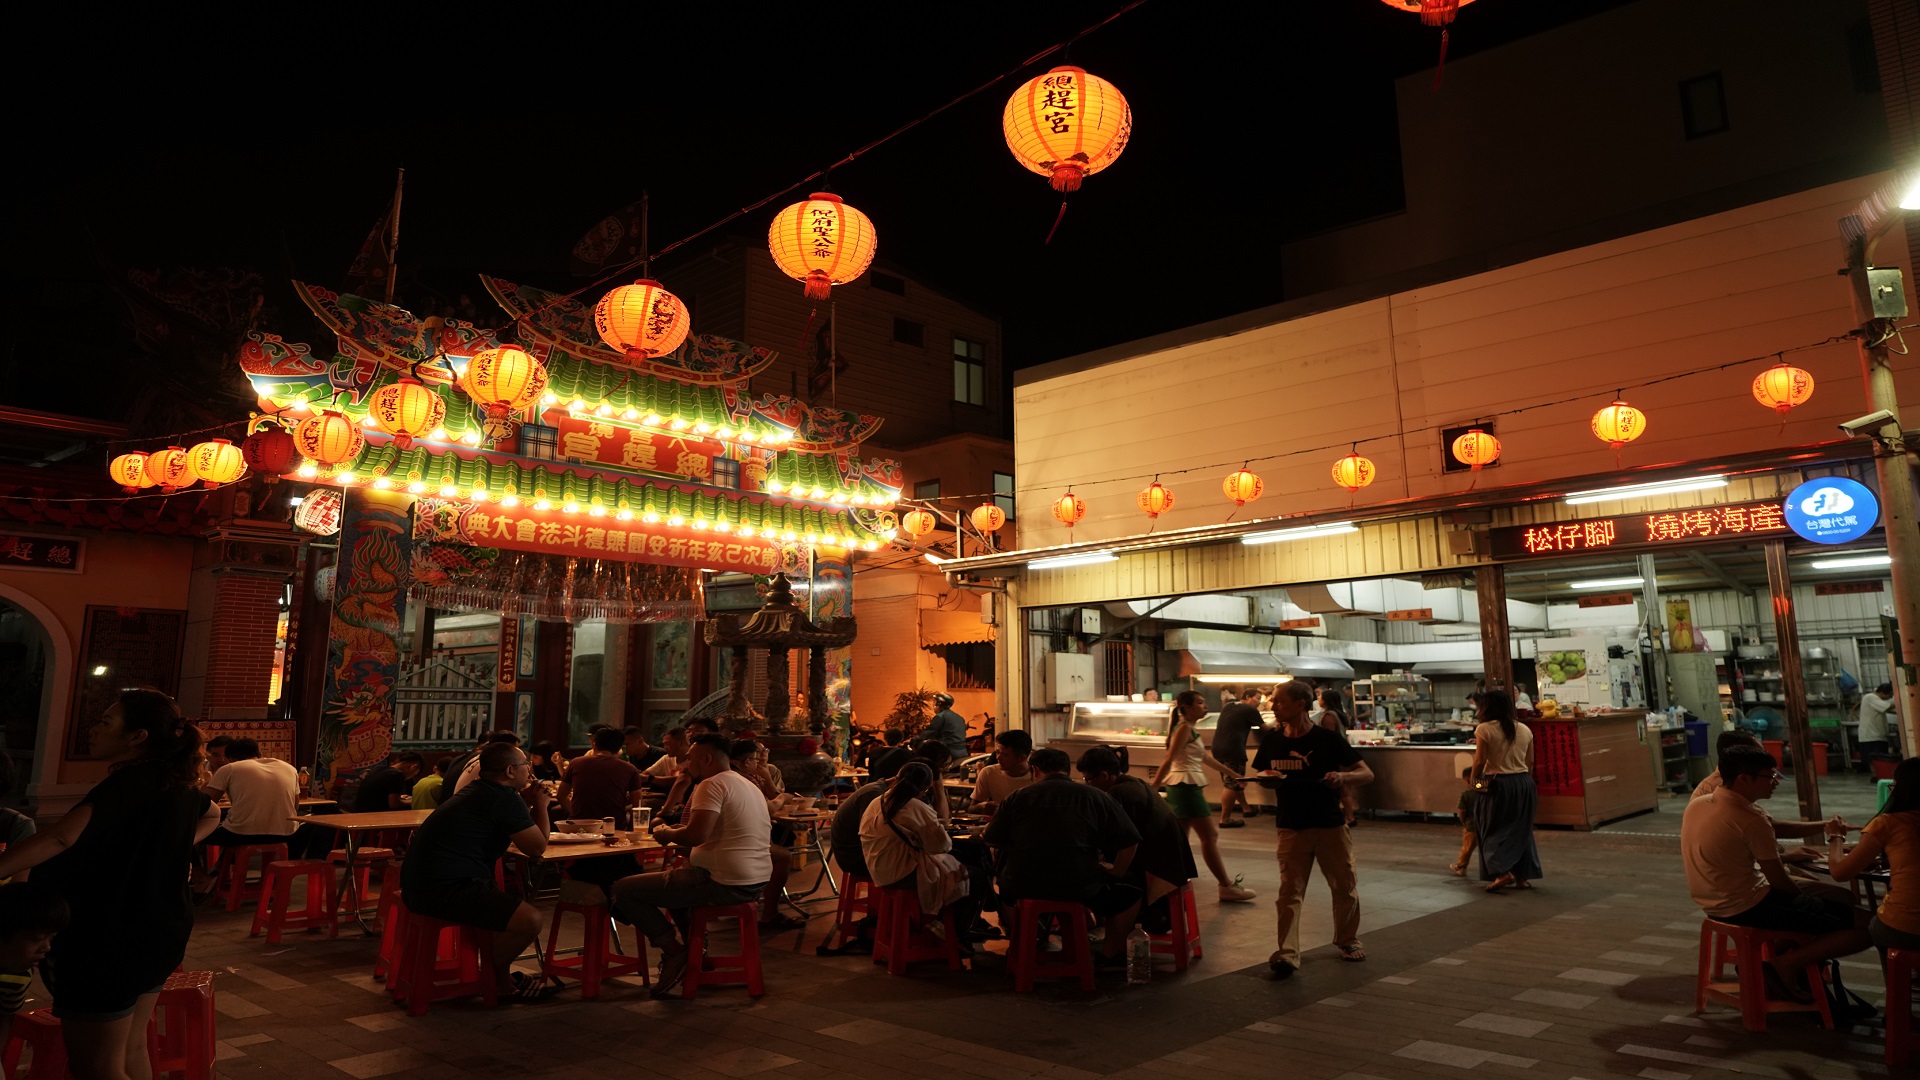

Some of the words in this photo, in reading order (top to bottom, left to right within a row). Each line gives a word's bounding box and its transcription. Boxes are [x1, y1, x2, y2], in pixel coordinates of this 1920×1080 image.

[1041, 75, 1077, 134] 總趕宮
[380, 387, 400, 422] 總趕宮
[563, 431, 711, 479] 總趕宮
[1523, 519, 1616, 553] 松仔腳
[1645, 503, 1786, 542] 燒烤海產
[1805, 515, 1858, 531] 台灣代駕
[1270, 759, 1303, 771] PUMA
